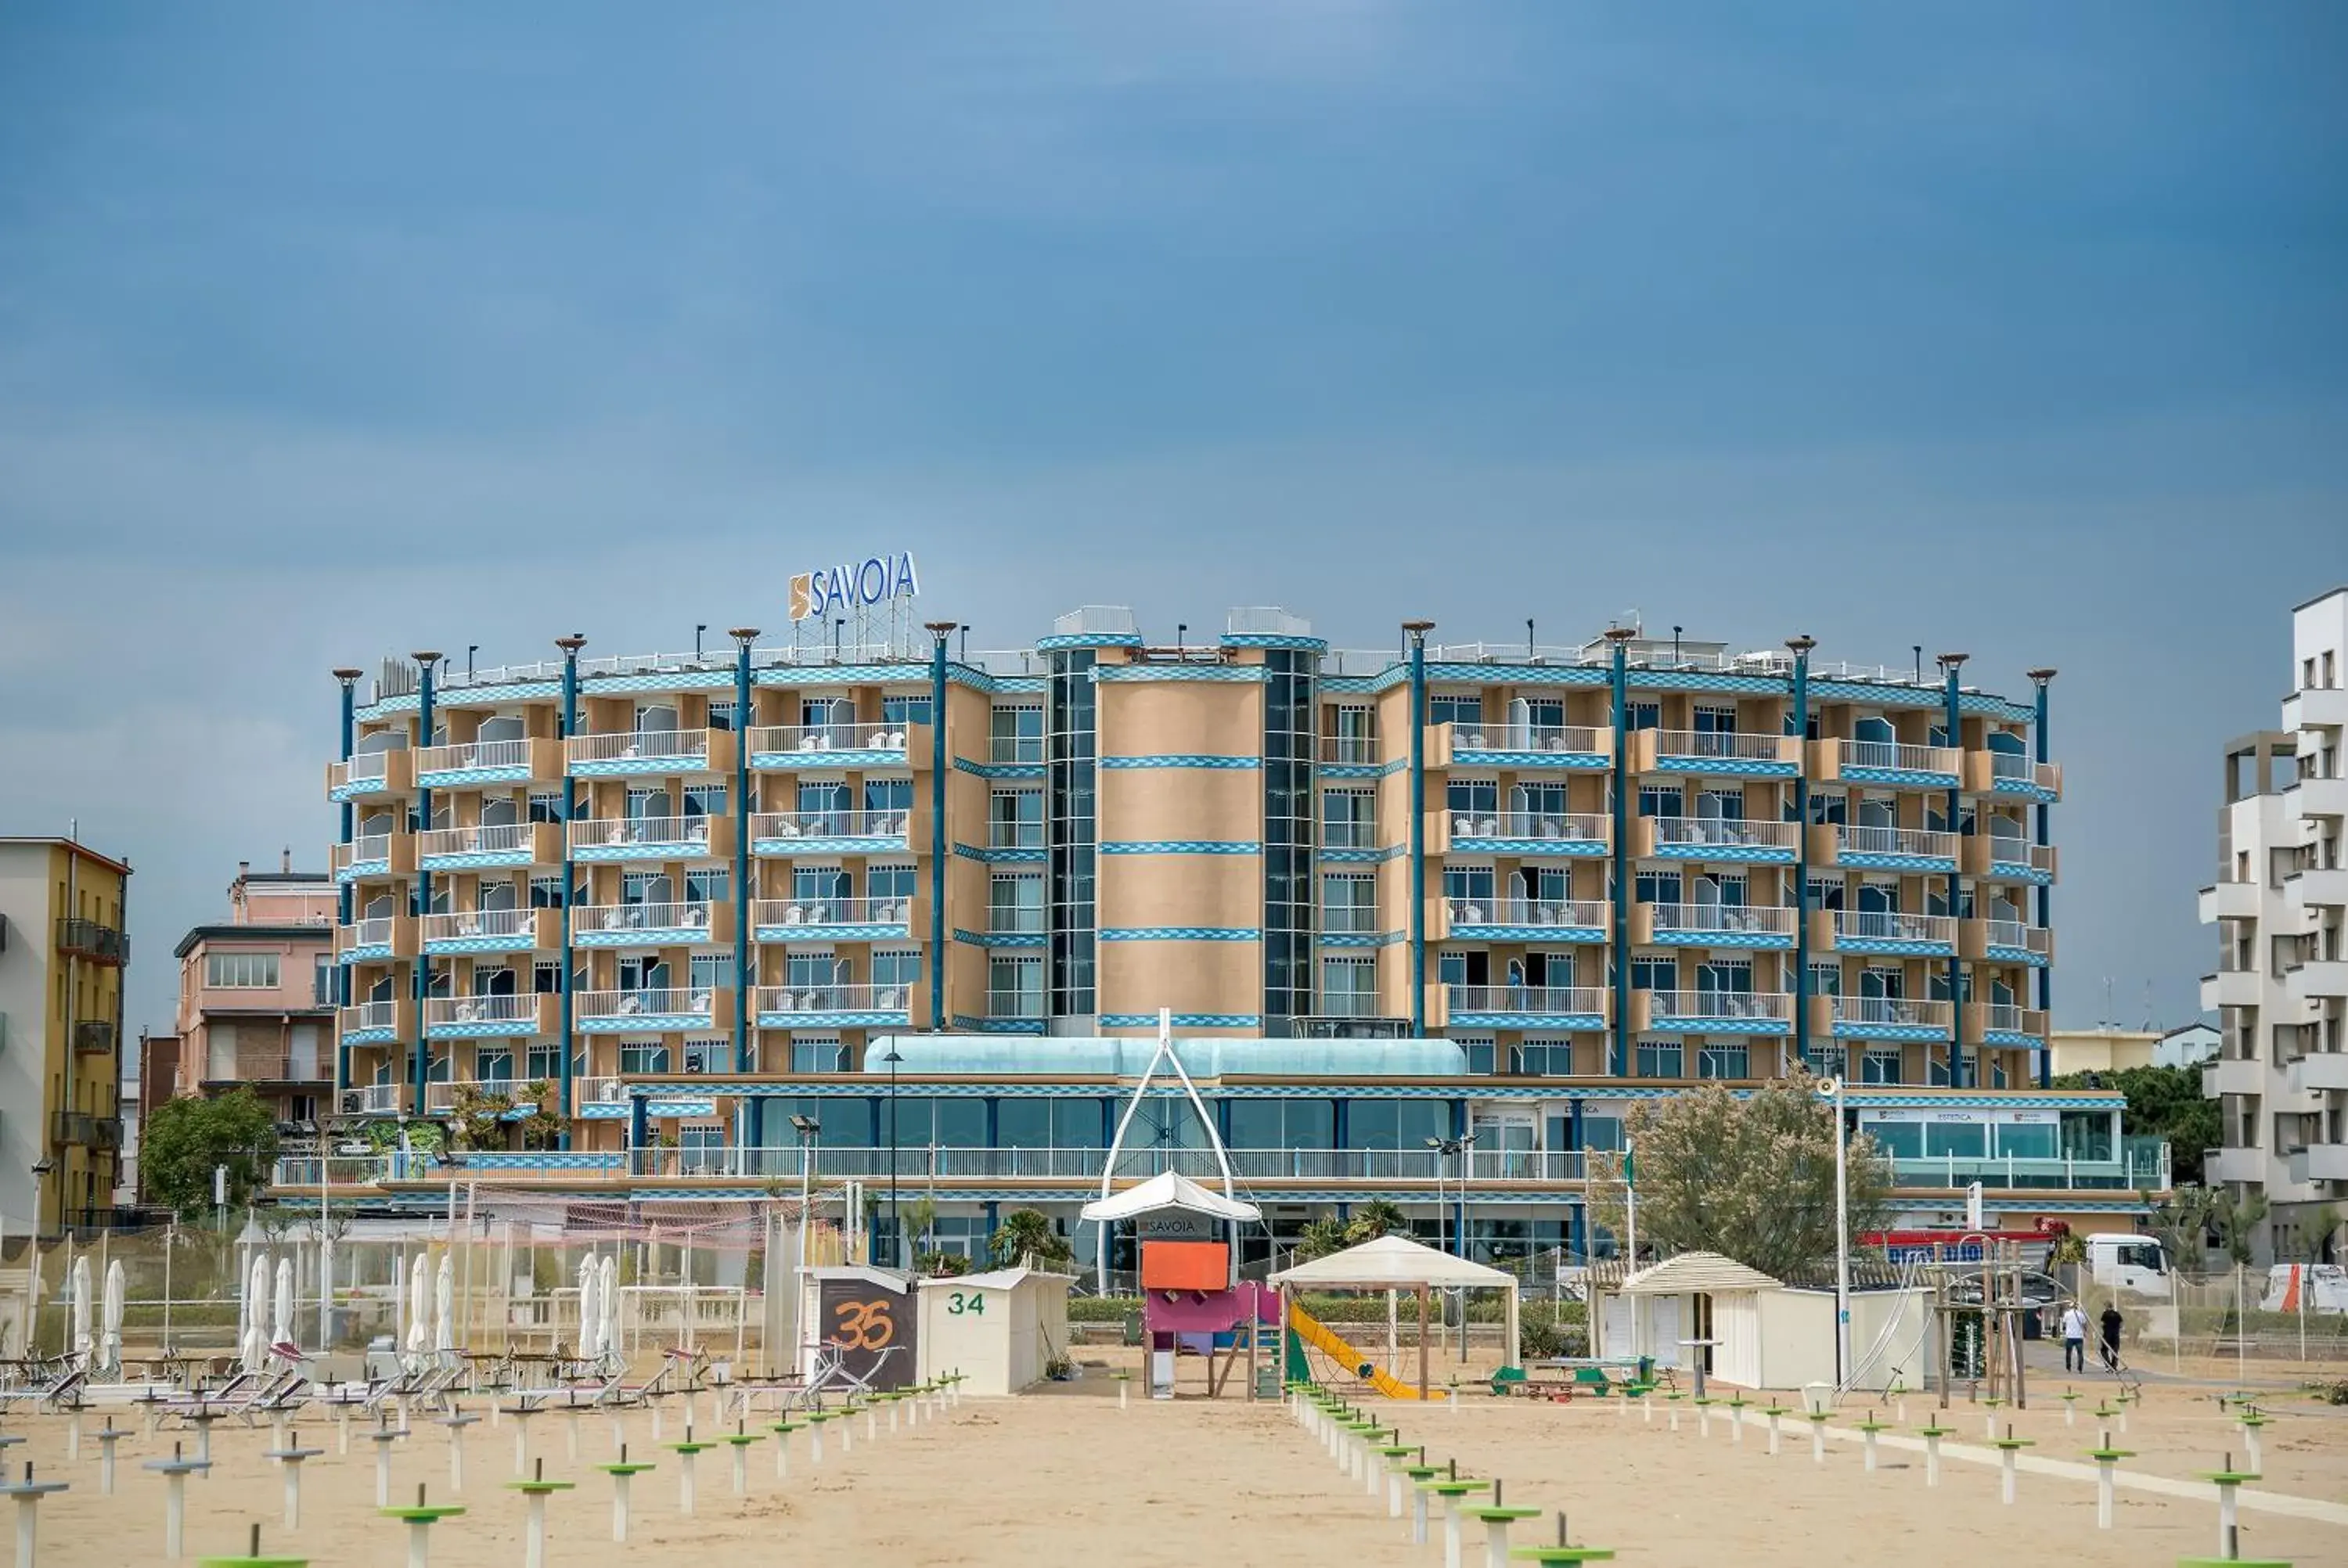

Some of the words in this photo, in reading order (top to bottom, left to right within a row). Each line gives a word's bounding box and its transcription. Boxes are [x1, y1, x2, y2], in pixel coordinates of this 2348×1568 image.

[812, 551, 919, 616] SAVOIA
[1150, 1220, 1195, 1232] SAVOIA
[948, 1293, 985, 1316] 34
[830, 1300, 893, 1351] 35
